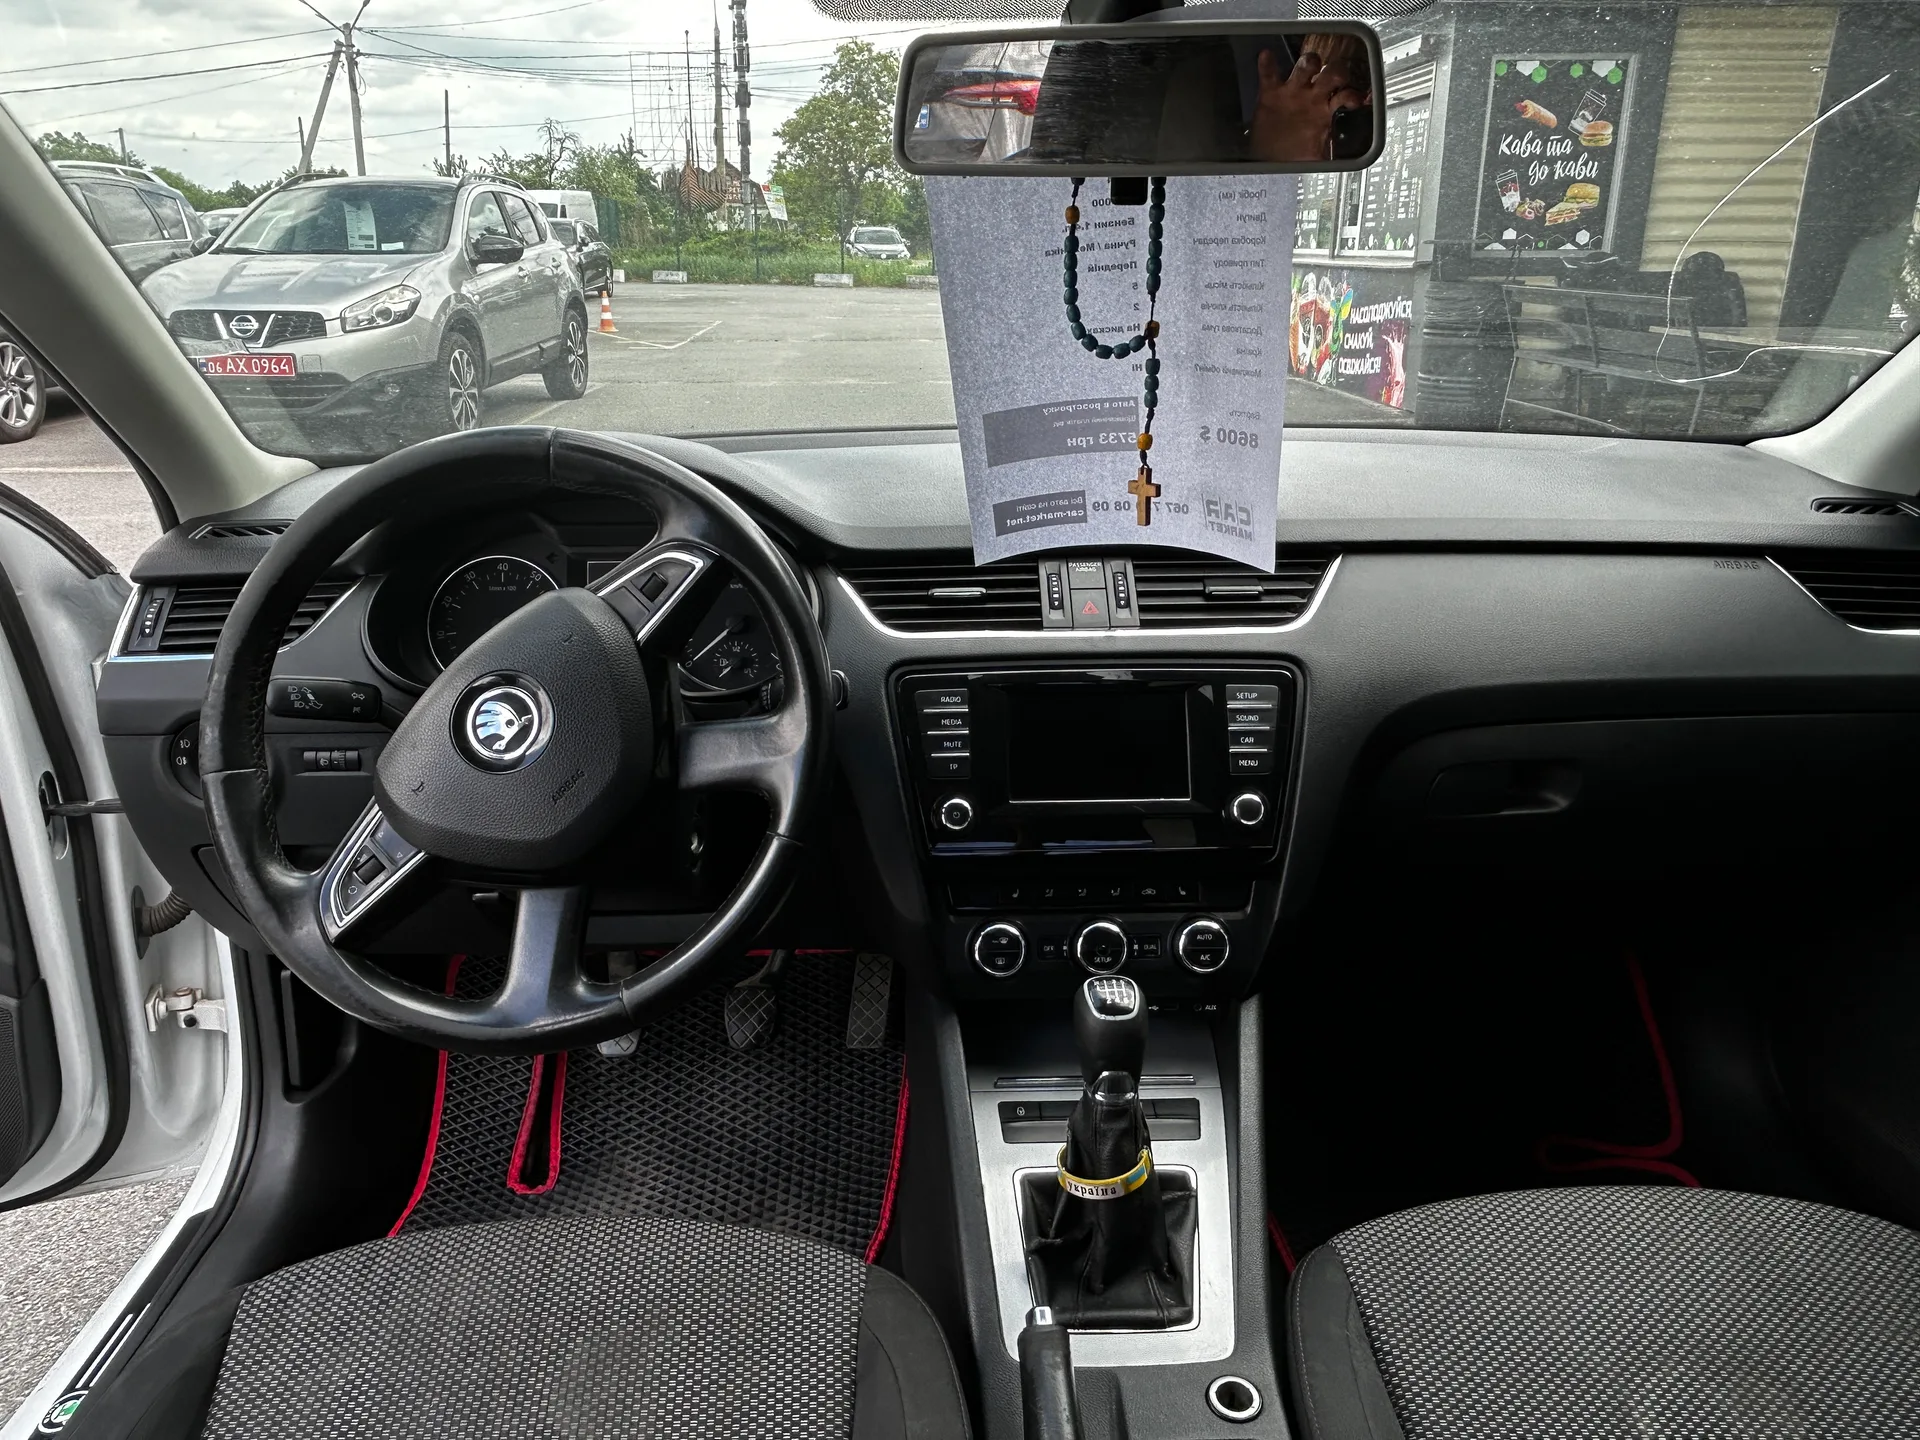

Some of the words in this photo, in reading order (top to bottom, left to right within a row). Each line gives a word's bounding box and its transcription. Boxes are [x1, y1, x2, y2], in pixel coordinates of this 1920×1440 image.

[1498, 130, 1543, 158] Кава
[1546, 135, 1574, 157] та
[1528, 160, 1550, 186] до
[1554, 152, 1599, 180] кави
[208, 362, 223, 373] 06
[226, 357, 248, 373] AX
[251, 358, 289, 373] 0964
[497, 562, 509, 571] 40
[1713, 560, 1760, 570] AIRBAG
[464, 570, 476, 582] 30
[529, 570, 542, 581] 50
[442, 595, 453, 608] 20
[437, 630, 445, 639] 10
[1236, 714, 1259, 722] SOUND
[1238, 759, 1259, 767] MENU
[552, 769, 585, 805] AIRBAG
[1196, 933, 1213, 941] AUTO
[1204, 1003, 1217, 1011] AUX
[1067, 1181, 1117, 1197] україна
